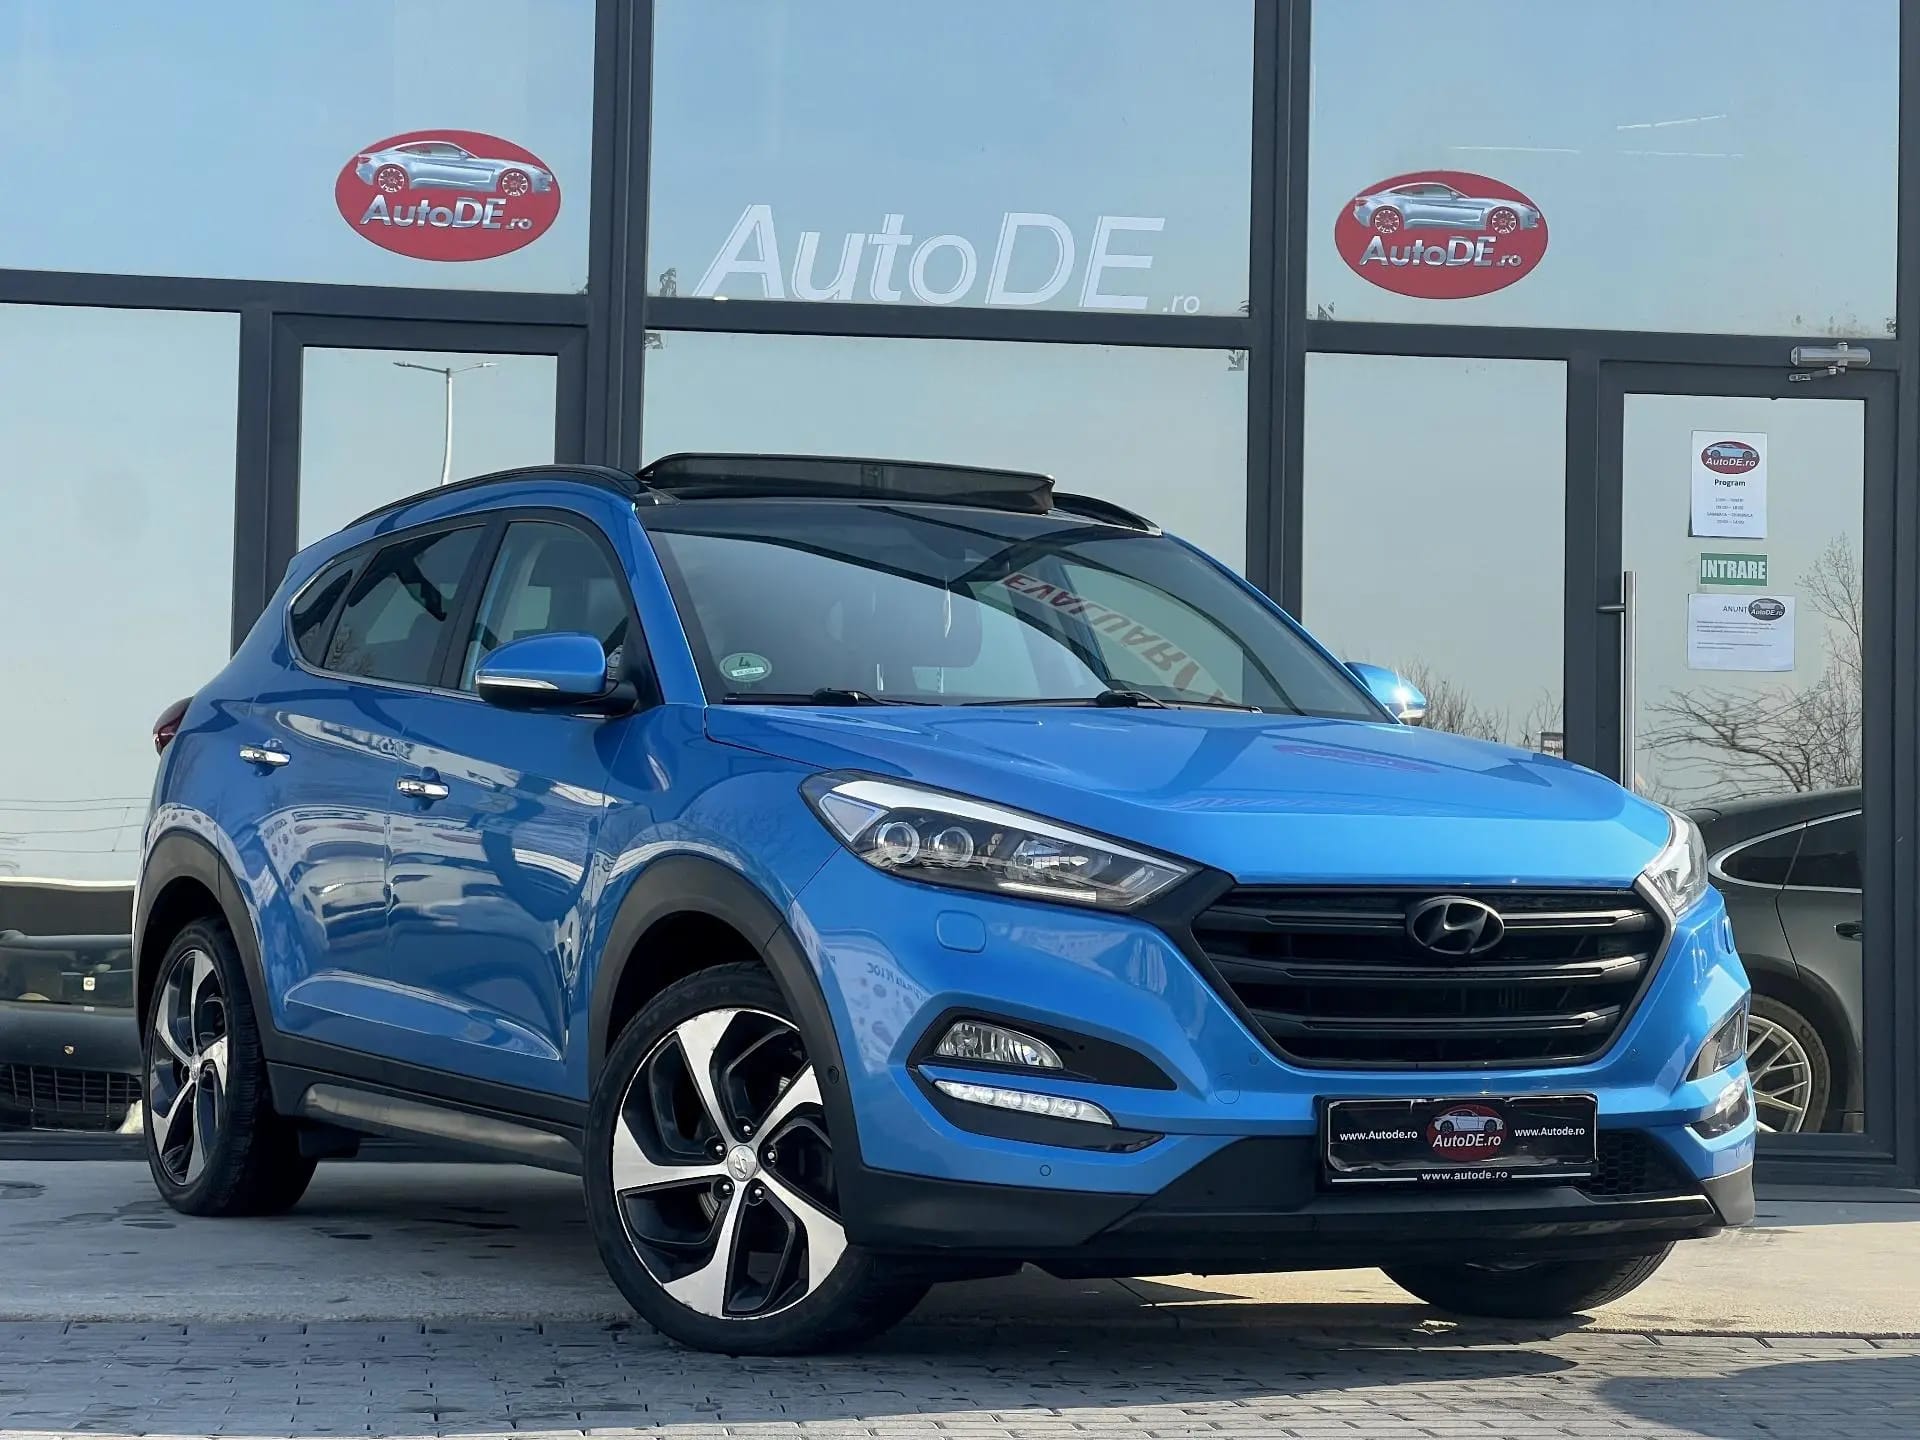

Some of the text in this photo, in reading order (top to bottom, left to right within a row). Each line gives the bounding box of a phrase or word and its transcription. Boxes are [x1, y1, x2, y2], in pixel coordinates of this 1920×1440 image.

[1705, 457, 1756, 467] AutoDE.ro
[1714, 479, 1746, 487] Program
[1701, 559, 1767, 580] INTRARE
[1339, 1130, 1418, 1141] www.Autode.ro
[1514, 1125, 1585, 1137] www.Autode.ro
[1432, 1133, 1502, 1149] AutoDE.ro
[1421, 1169, 1508, 1181] www.autode.ro
